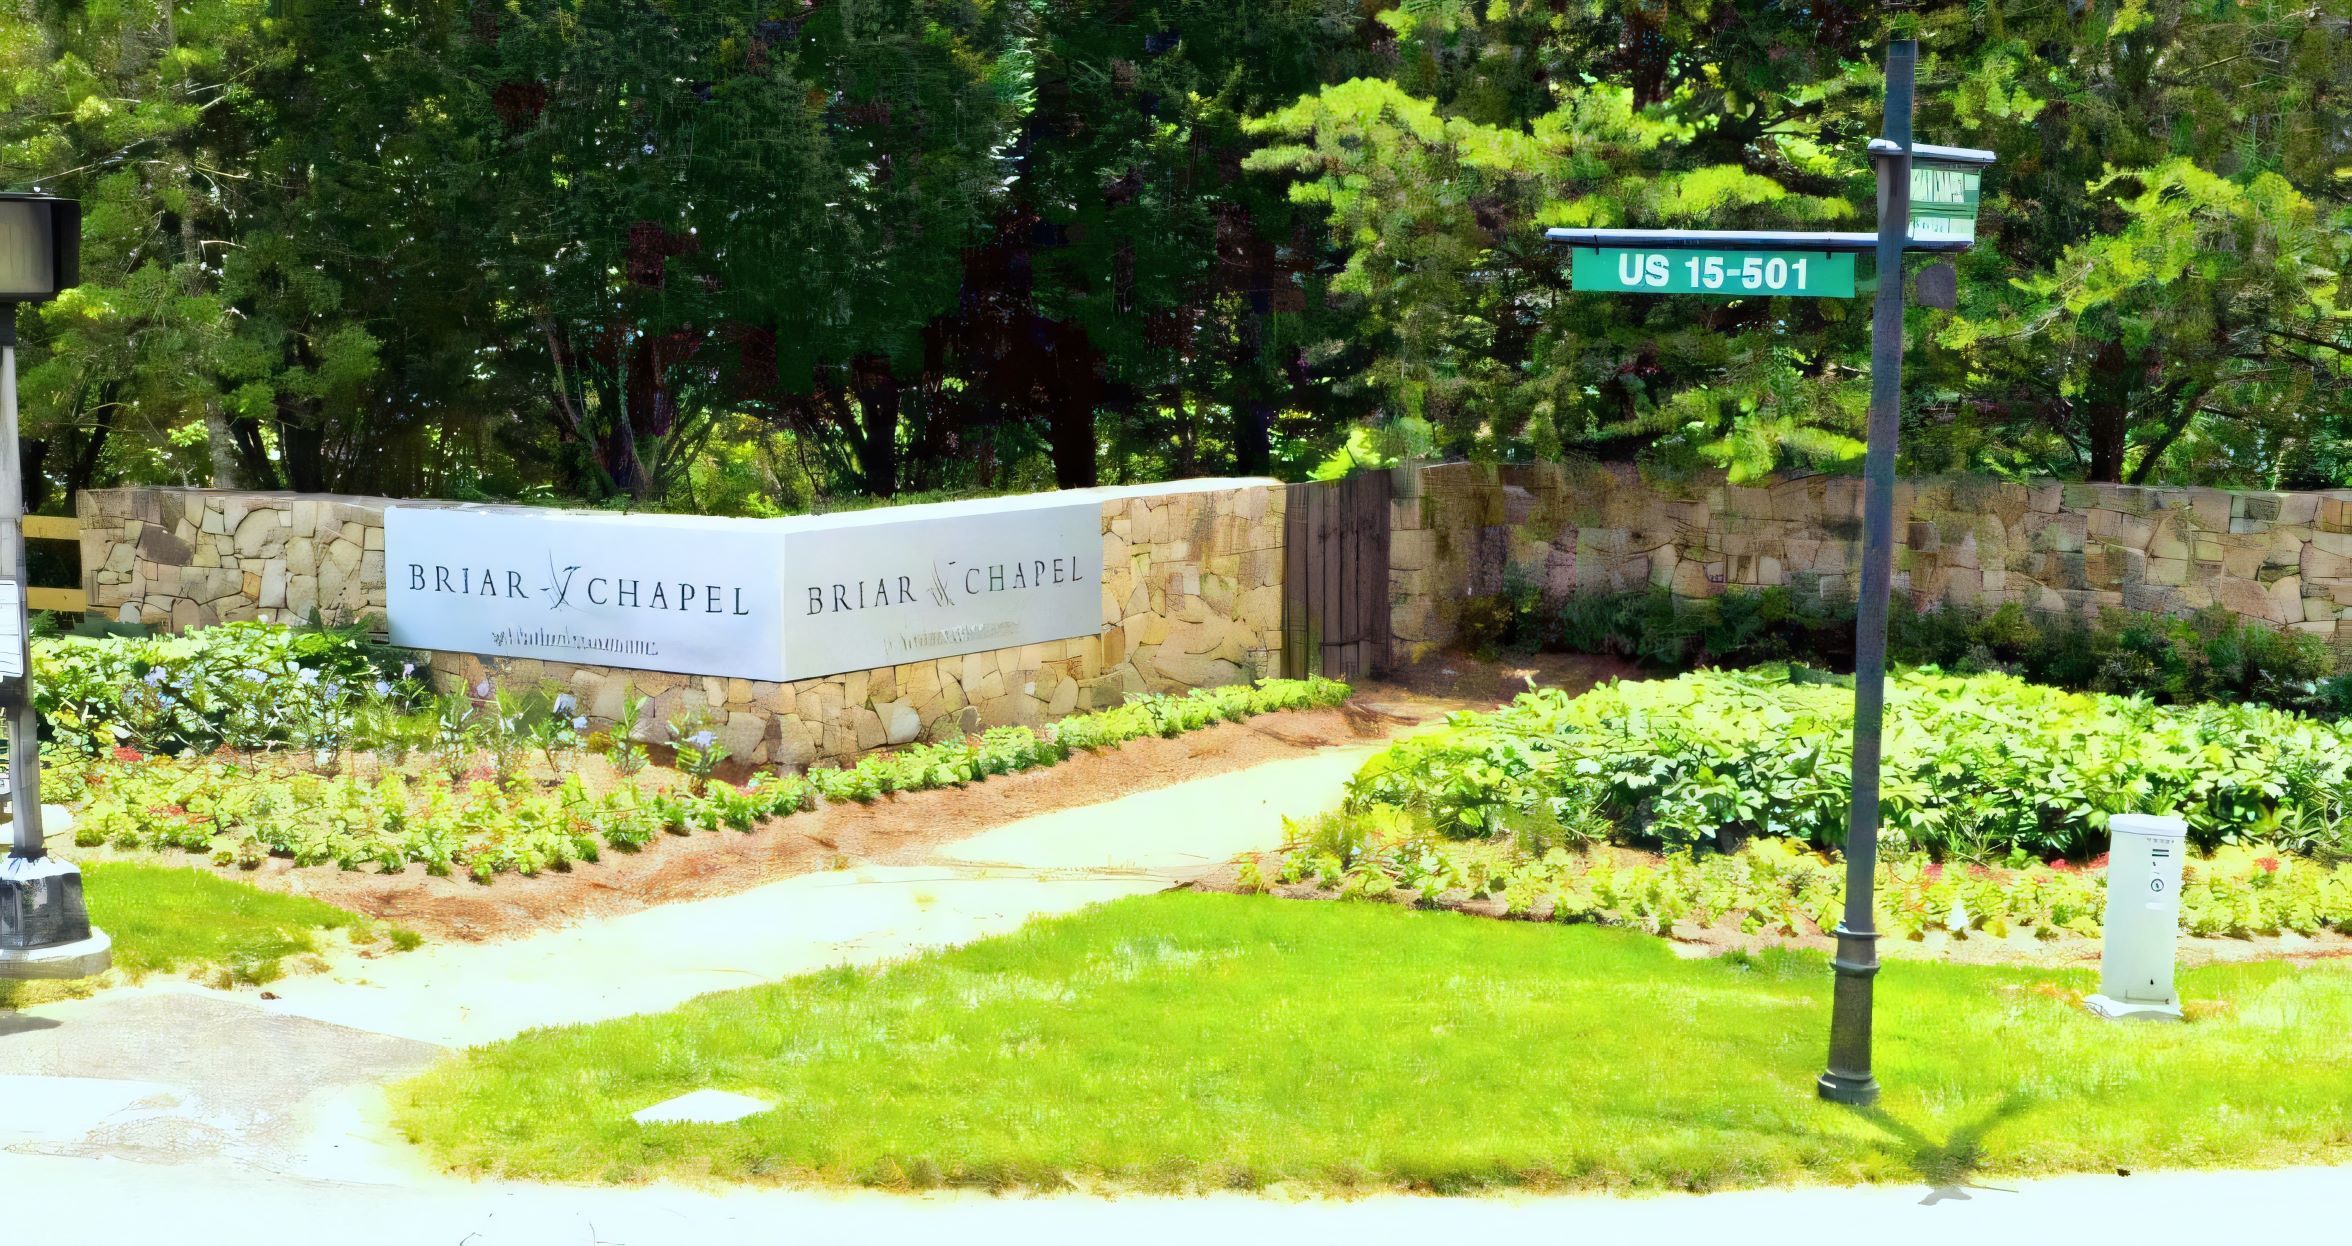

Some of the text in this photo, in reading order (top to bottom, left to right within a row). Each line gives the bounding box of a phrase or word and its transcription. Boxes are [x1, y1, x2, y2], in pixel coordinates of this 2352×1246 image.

[1618, 253, 1807, 289] US 15-501
[408, 563, 749, 616] BRIAR CHAPEL
[806, 556, 1083, 615] BRIAR CHAPEL
